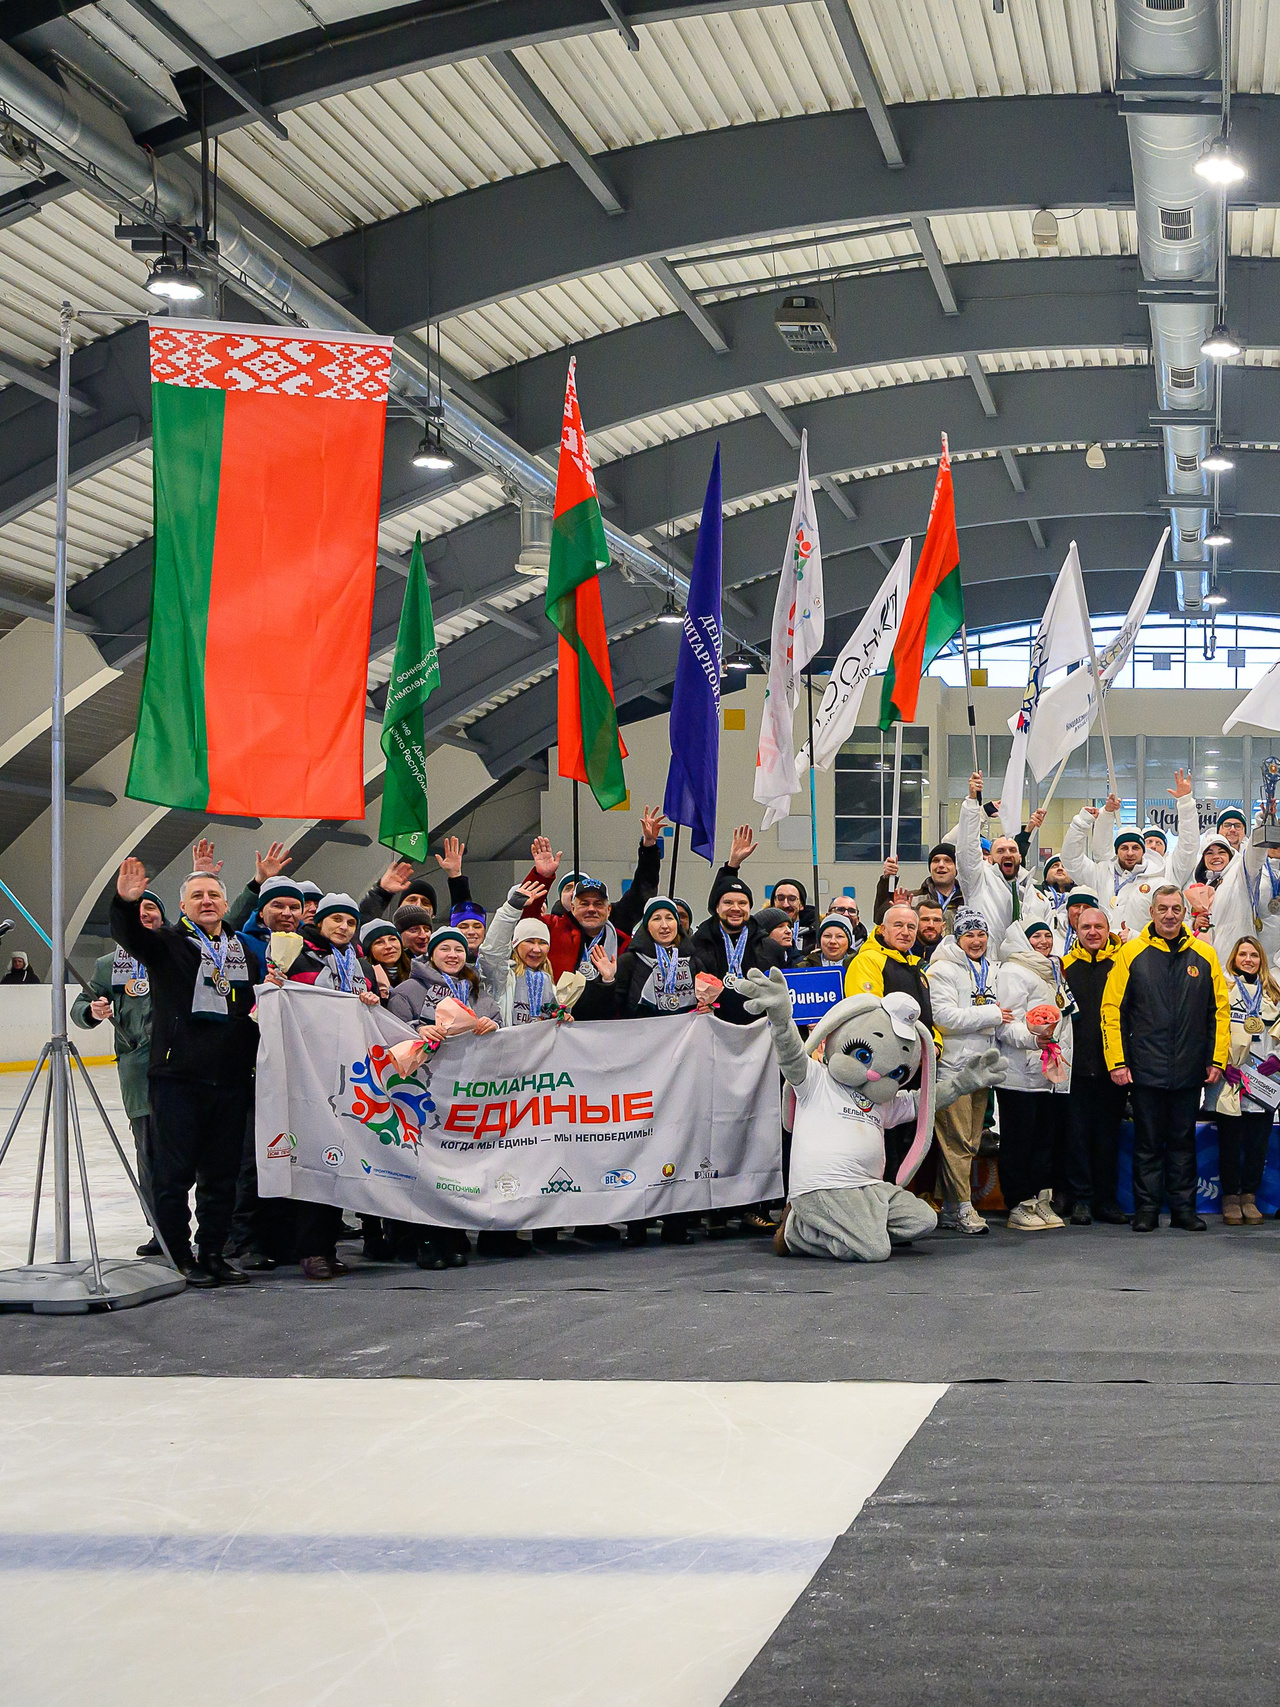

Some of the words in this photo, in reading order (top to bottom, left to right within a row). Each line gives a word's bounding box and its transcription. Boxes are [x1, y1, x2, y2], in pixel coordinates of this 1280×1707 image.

[788, 988, 837, 1005] диные
[452, 1071, 575, 1098] КОМАНДА
[443, 1090, 654, 1140] ЕДИНЫЕ
[440, 1140, 474, 1152] КОГДА
[476, 1140, 495, 1150] МЫ
[498, 1136, 538, 1149] ЕДИНЫ
[554, 1132, 572, 1143] МЫ
[575, 1128, 654, 1143] НЕПОБЕДИМЫ!
[436, 1181, 481, 1195] ВОСТОЧНЫЙ
